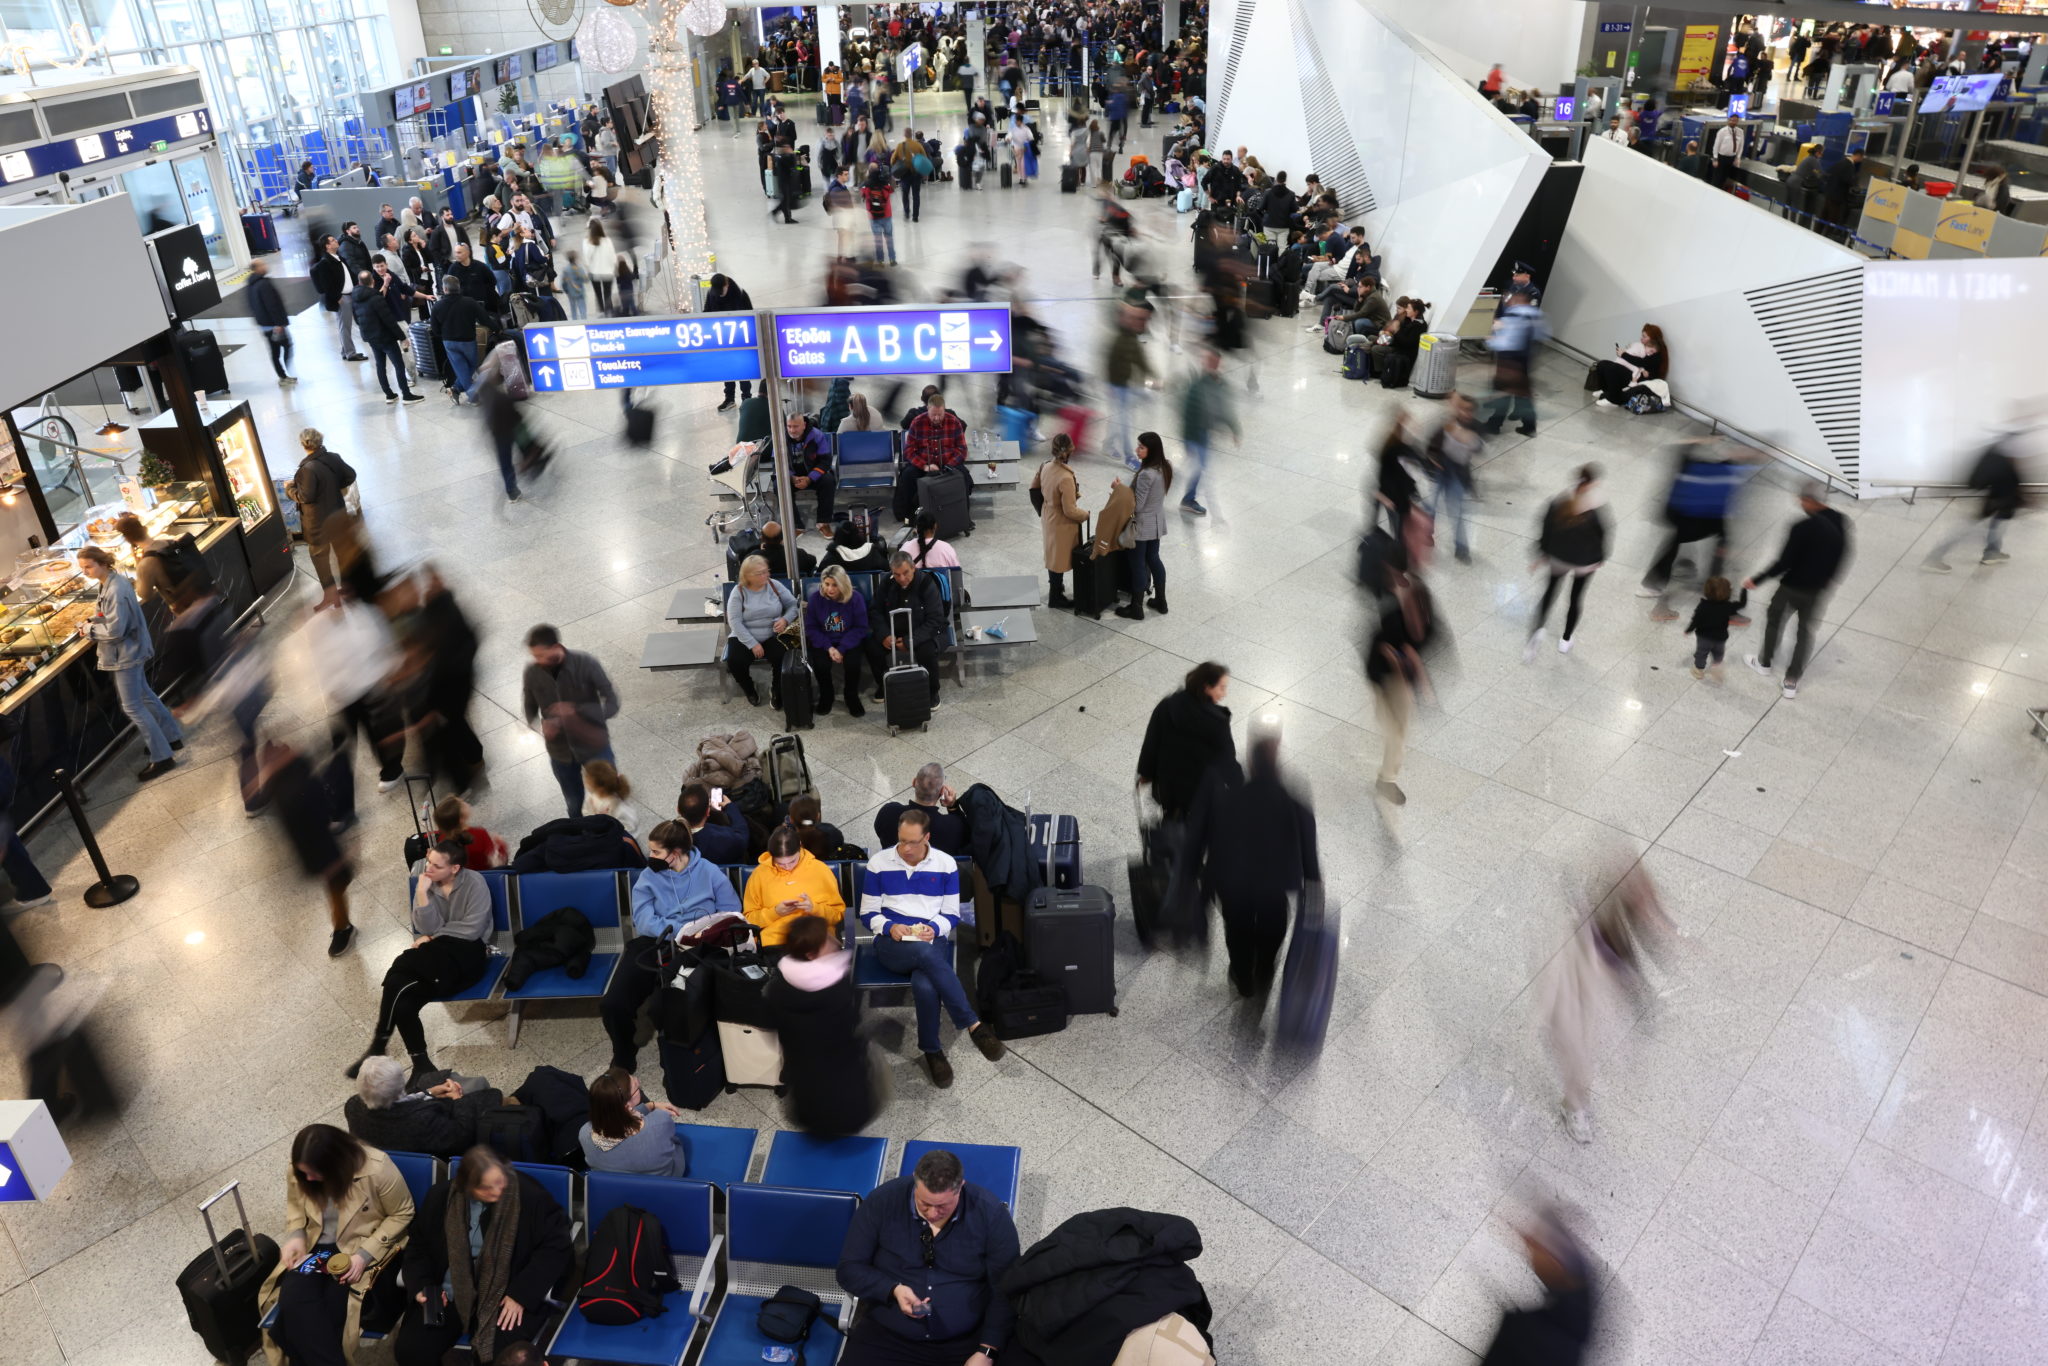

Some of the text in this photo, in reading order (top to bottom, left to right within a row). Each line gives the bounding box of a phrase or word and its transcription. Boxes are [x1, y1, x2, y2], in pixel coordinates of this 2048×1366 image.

[1558, 102, 1571, 115] 16
[1732, 99, 1745, 113] 15
[1879, 98, 1891, 111] 14
[198, 111, 209, 131] 3
[1950, 219, 1968, 232] Fast
[175, 278, 192, 291] coffee
[675, 321, 750, 348] 93-171
[782, 328, 831, 347] Έξοδοι
[591, 341, 625, 352] Check-in
[840, 323, 937, 363] A B C
[788, 349, 826, 365] Gates
[596, 359, 642, 372] Τουαλέτες
[599, 374, 625, 384] Toilets
